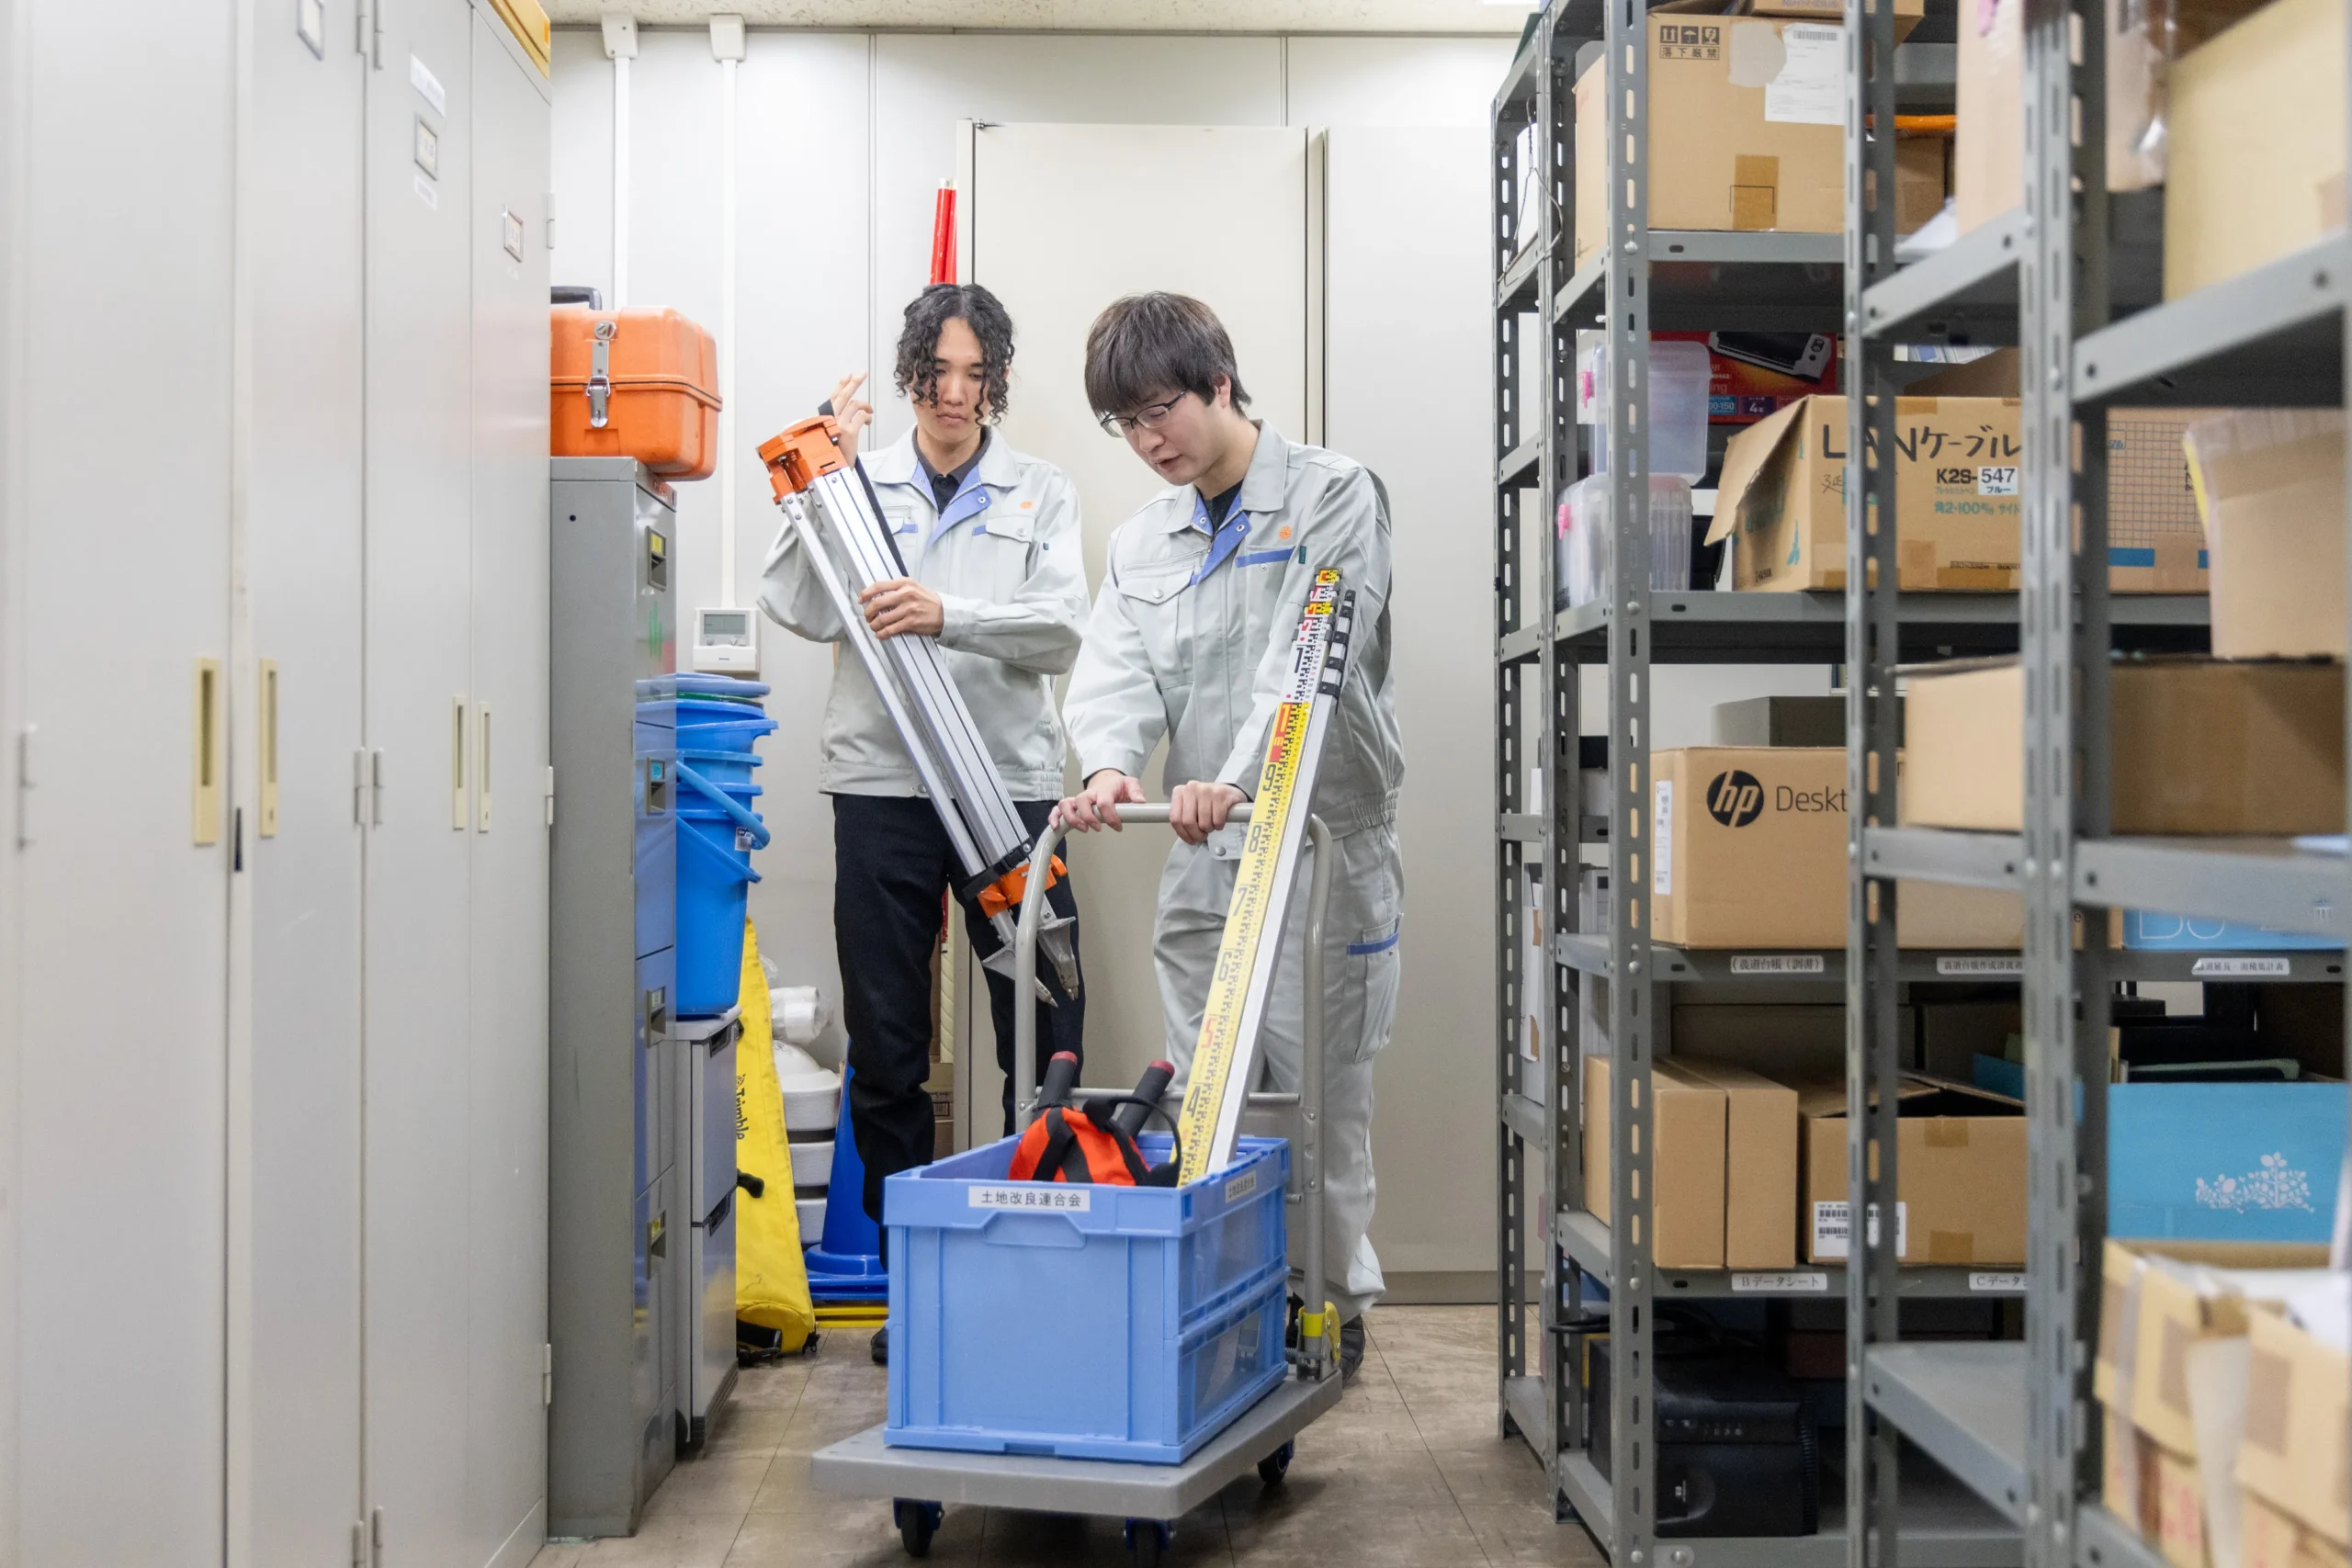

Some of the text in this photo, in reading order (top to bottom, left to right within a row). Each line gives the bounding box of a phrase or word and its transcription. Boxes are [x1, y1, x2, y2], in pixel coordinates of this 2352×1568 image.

[1262, 763, 1276, 791] 9
[1707, 770, 1764, 827] hp
[1249, 824, 1262, 852] 8
[1233, 886, 1248, 917] 7
[1217, 952, 1232, 981] 6
[981, 1190, 1081, 1207] 土地改良連合会
[1742, 1275, 1819, 1287] Bデータシート
